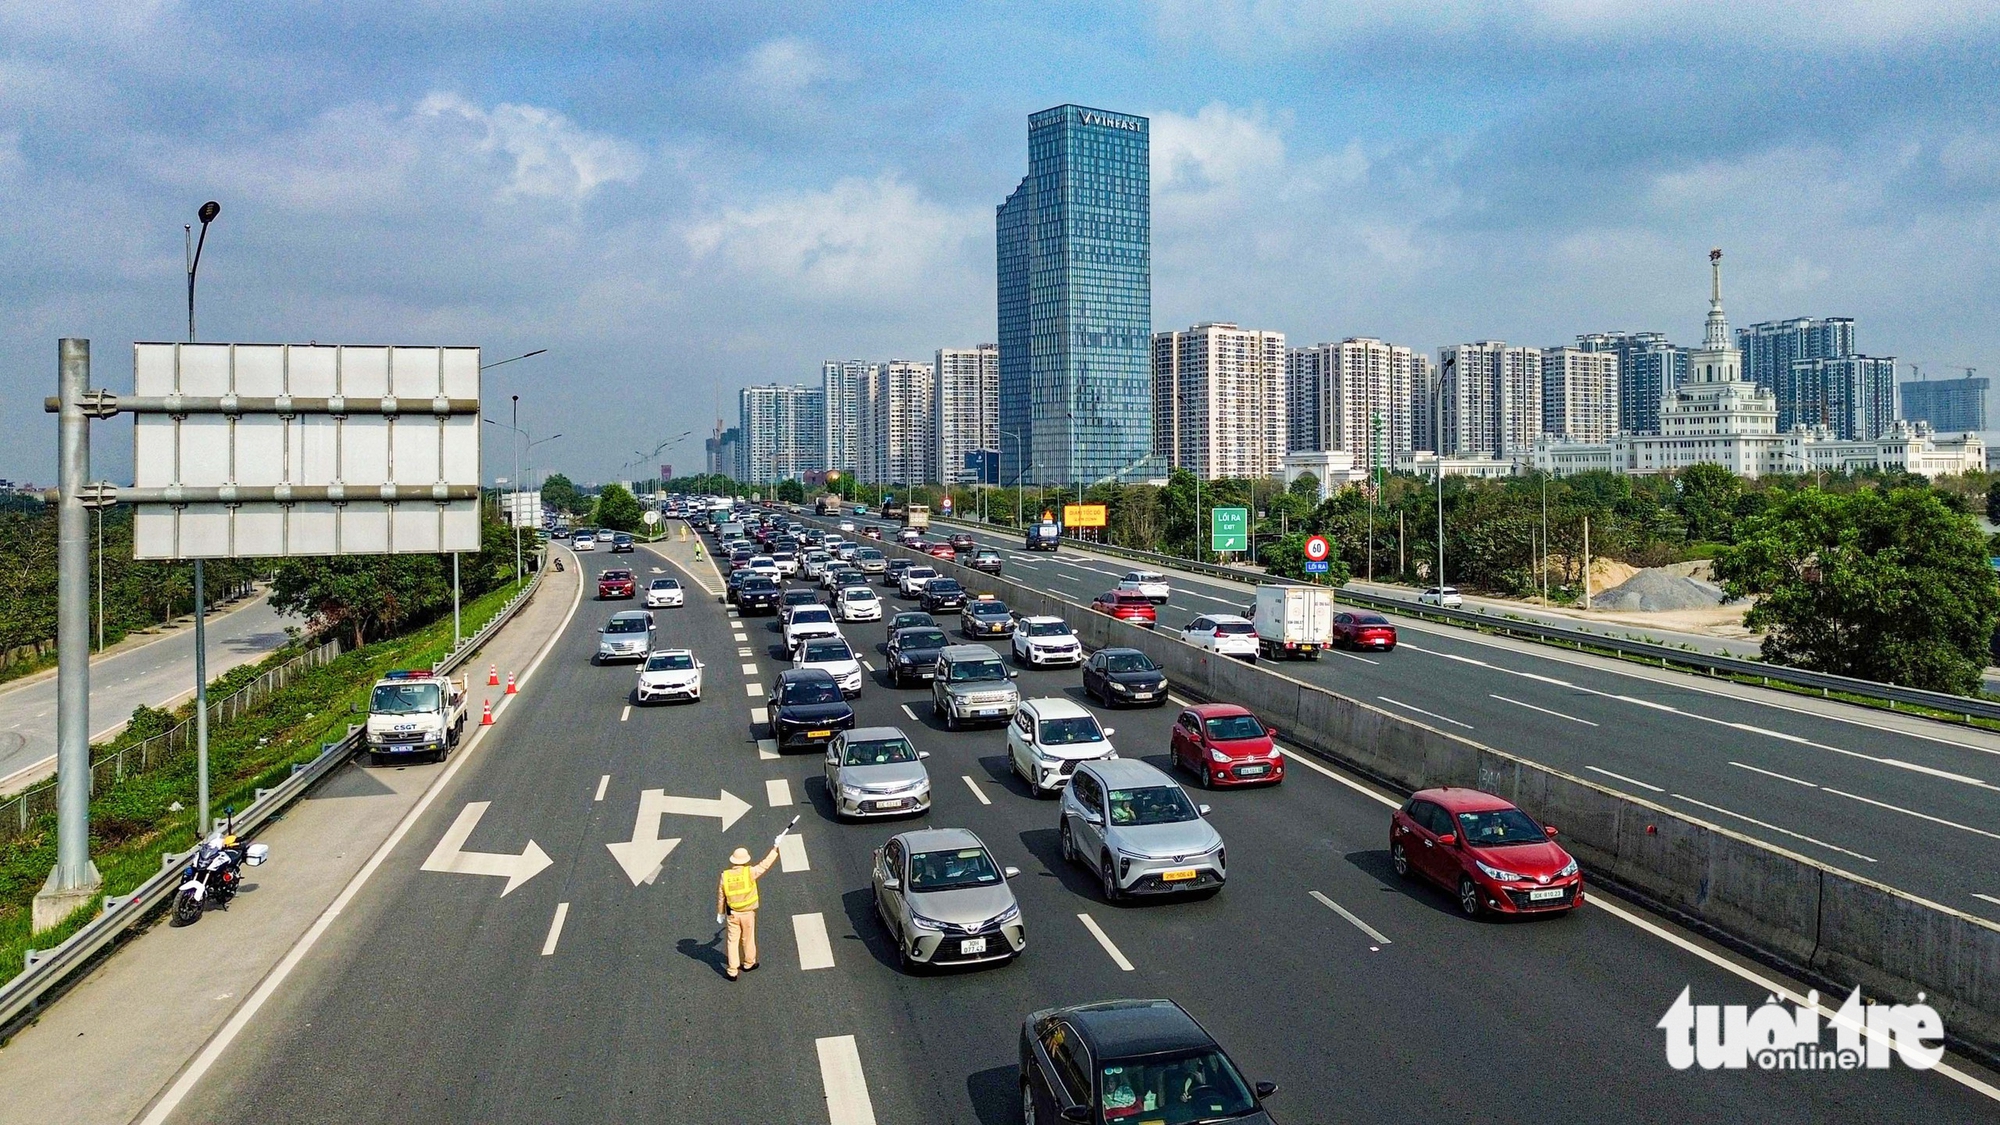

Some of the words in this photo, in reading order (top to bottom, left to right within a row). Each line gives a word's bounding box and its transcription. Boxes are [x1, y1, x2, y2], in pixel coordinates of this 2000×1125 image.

[1093, 114, 1142, 132] VINFAST
[1218, 512, 1230, 522] LỐI
[1231, 514, 1241, 522] RA
[1312, 543, 1322, 553] 60
[1308, 562, 1317, 570] LỐI
[393, 723, 417, 731] CSGT
